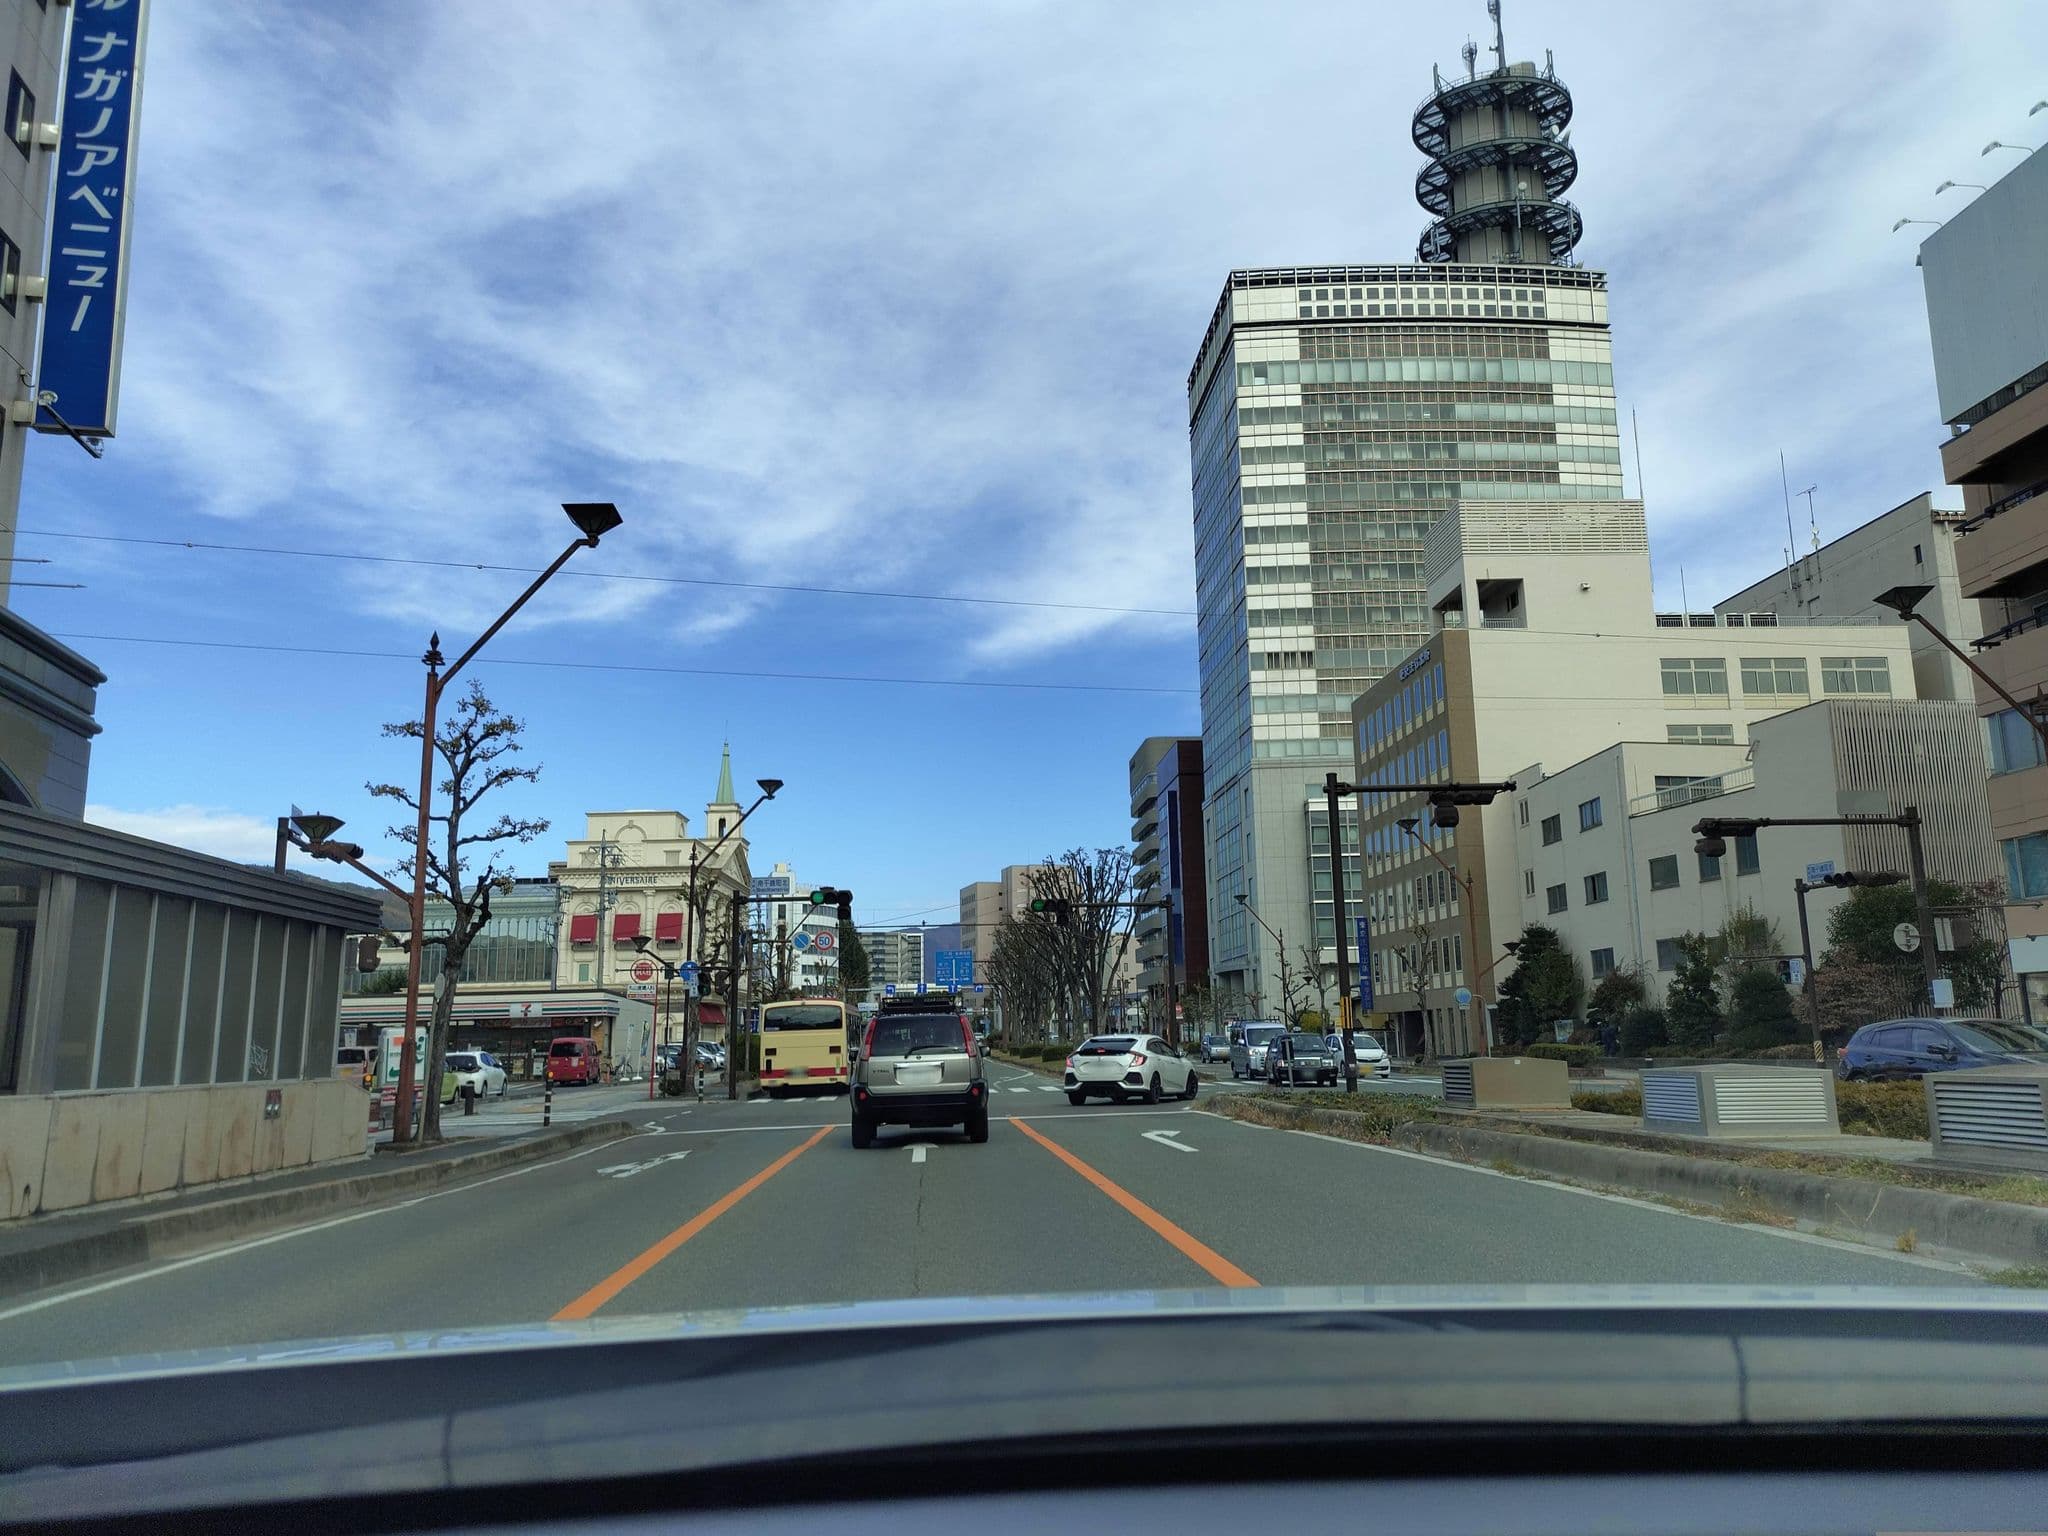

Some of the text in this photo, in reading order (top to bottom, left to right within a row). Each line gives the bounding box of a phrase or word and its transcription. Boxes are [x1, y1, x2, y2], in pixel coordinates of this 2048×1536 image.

[62, 31, 128, 332] ナガノアベニュー
[819, 937, 829, 945] 50
